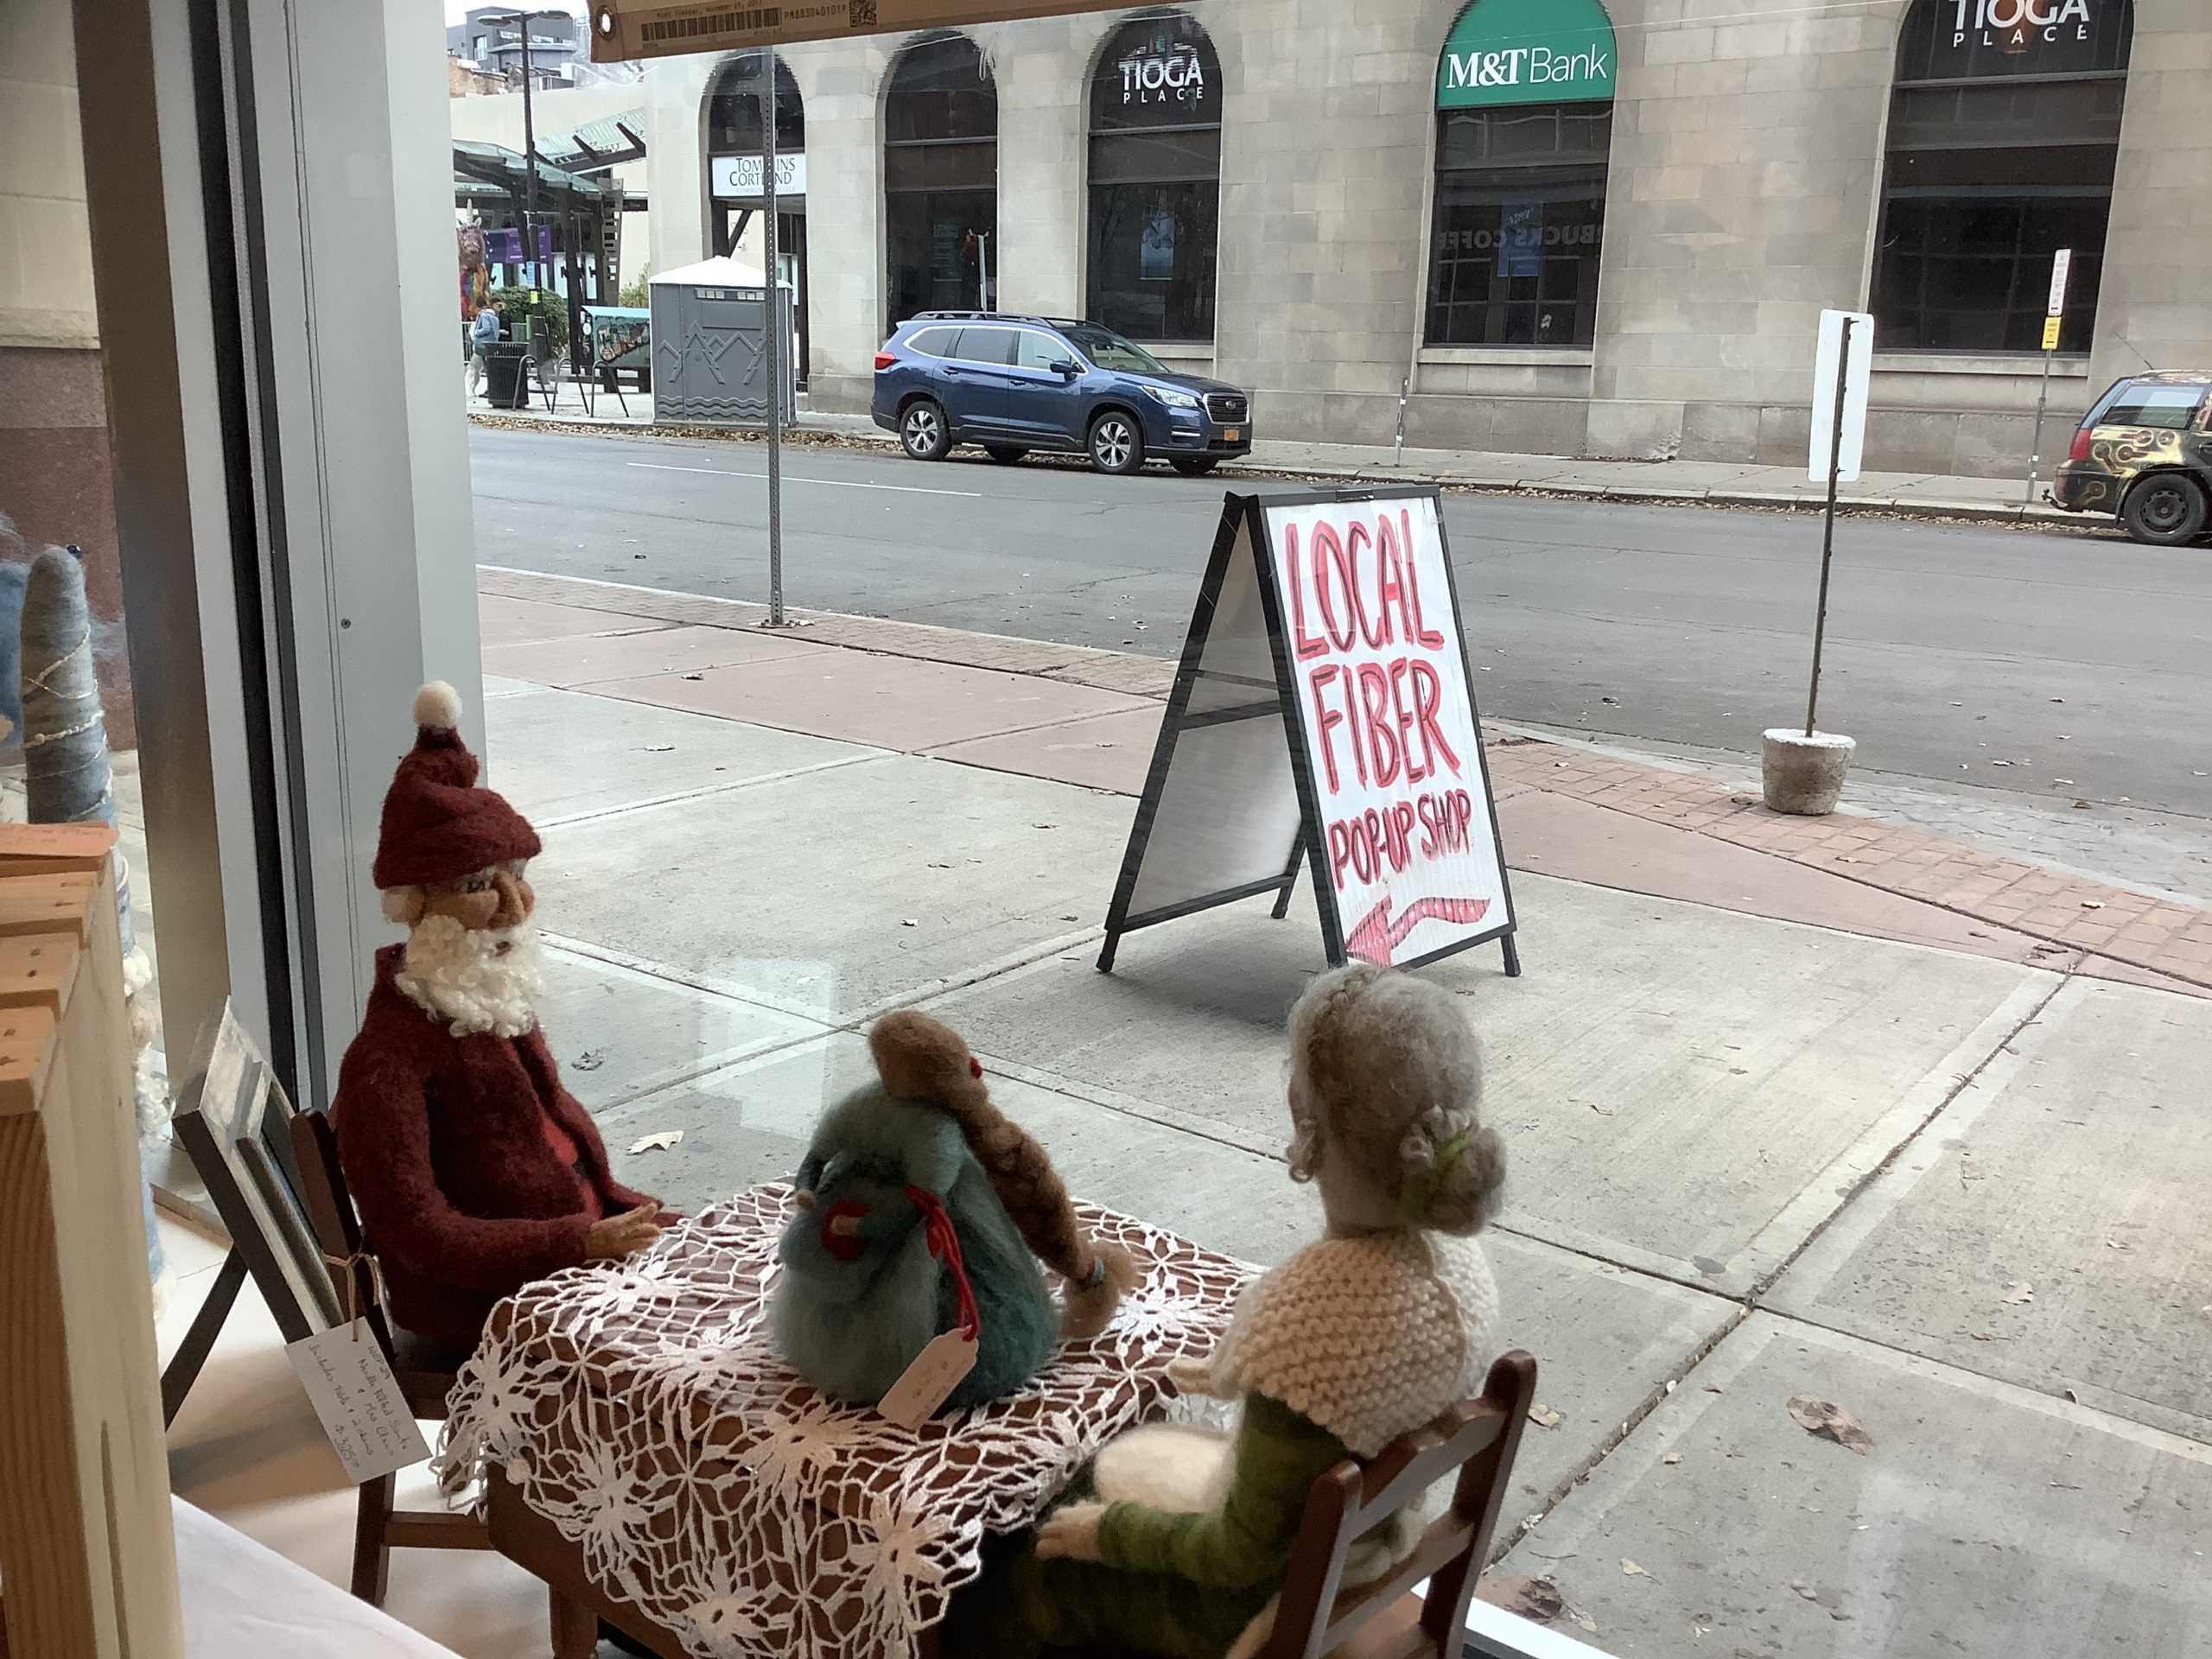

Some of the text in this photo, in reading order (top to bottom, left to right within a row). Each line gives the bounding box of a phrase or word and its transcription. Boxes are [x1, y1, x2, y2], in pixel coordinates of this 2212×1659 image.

[1948, 0, 2089, 29] TIOGA
[1953, 24, 2088, 48] PLACE
[1119, 54, 1204, 91] TIOGA
[1446, 43, 1609, 88] M&T Bank
[1124, 86, 1204, 105] PLACE
[735, 157, 796, 175] TOMINS
[1285, 508, 1446, 661] LOCAL
[1309, 658, 1462, 796] FIBER
[1418, 787, 1472, 861] SHOP
